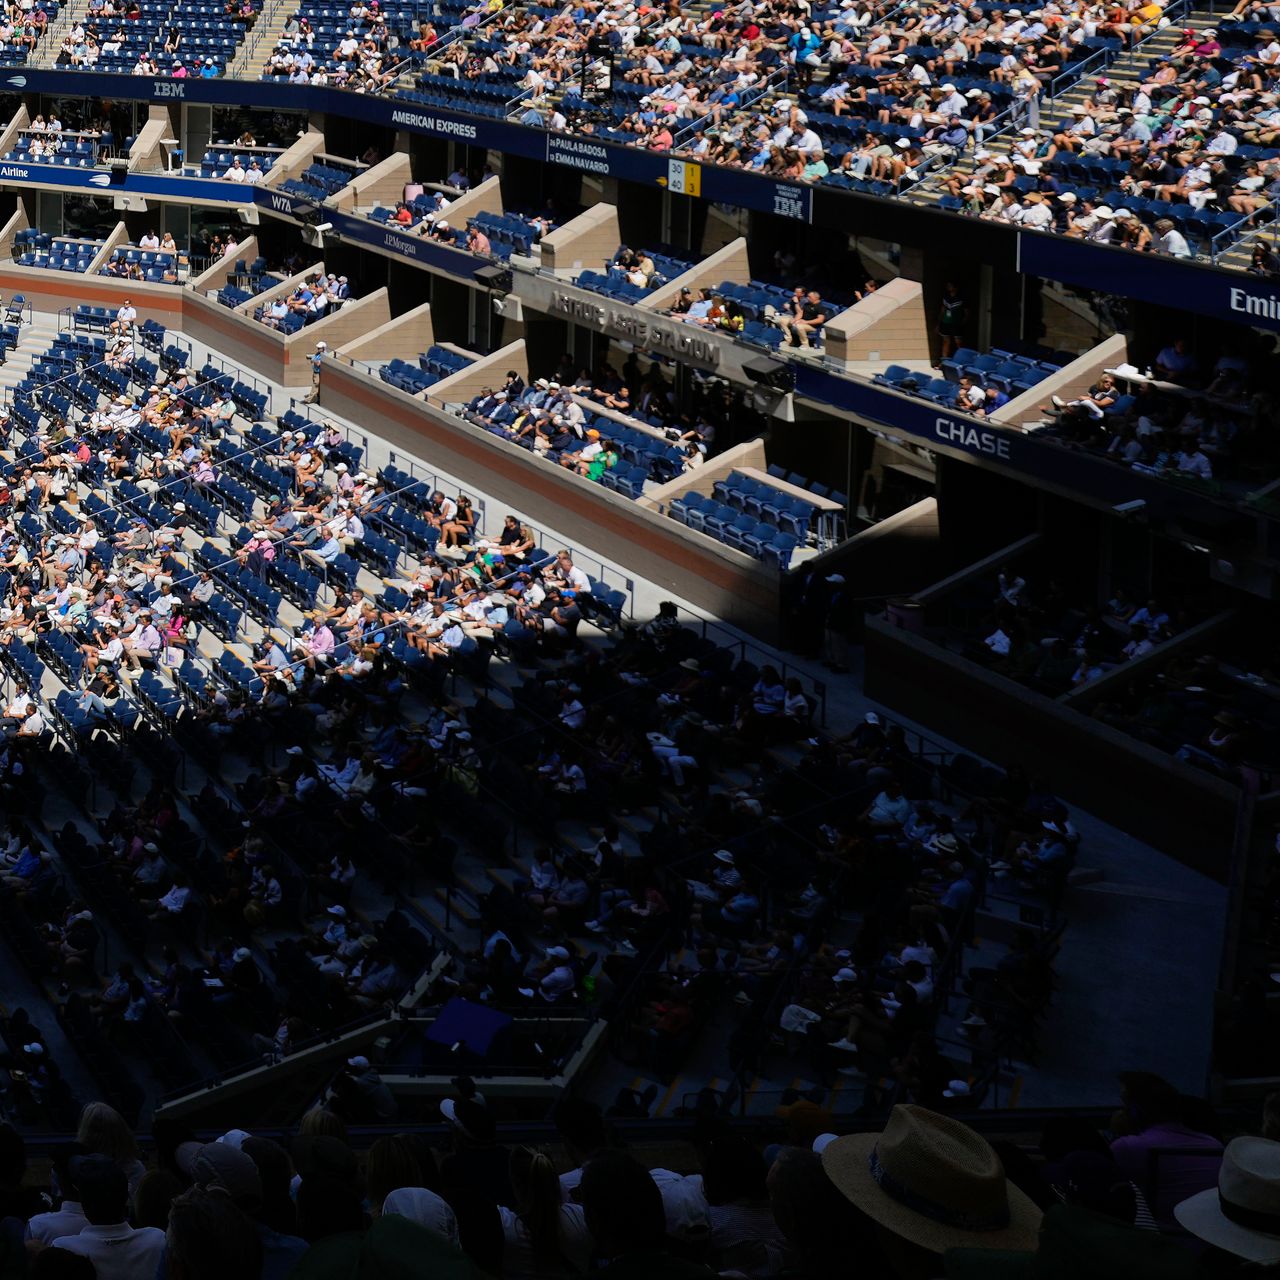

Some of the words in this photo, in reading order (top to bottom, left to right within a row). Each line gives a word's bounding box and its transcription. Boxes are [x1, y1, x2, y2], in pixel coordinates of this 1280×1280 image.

[153, 81, 185, 98] IBM
[391, 109, 436, 131] AMERICAN
[436, 119, 478, 140] EXPRESS
[0, 166, 28, 178] Airline
[671, 162, 682, 174] 30
[670, 179, 682, 191] 40
[271, 194, 292, 213] WTA
[773, 195, 804, 220] IBM
[549, 290, 606, 327] ARTHUR
[648, 325, 722, 367] STADIUM
[935, 417, 1012, 461] CHASE
